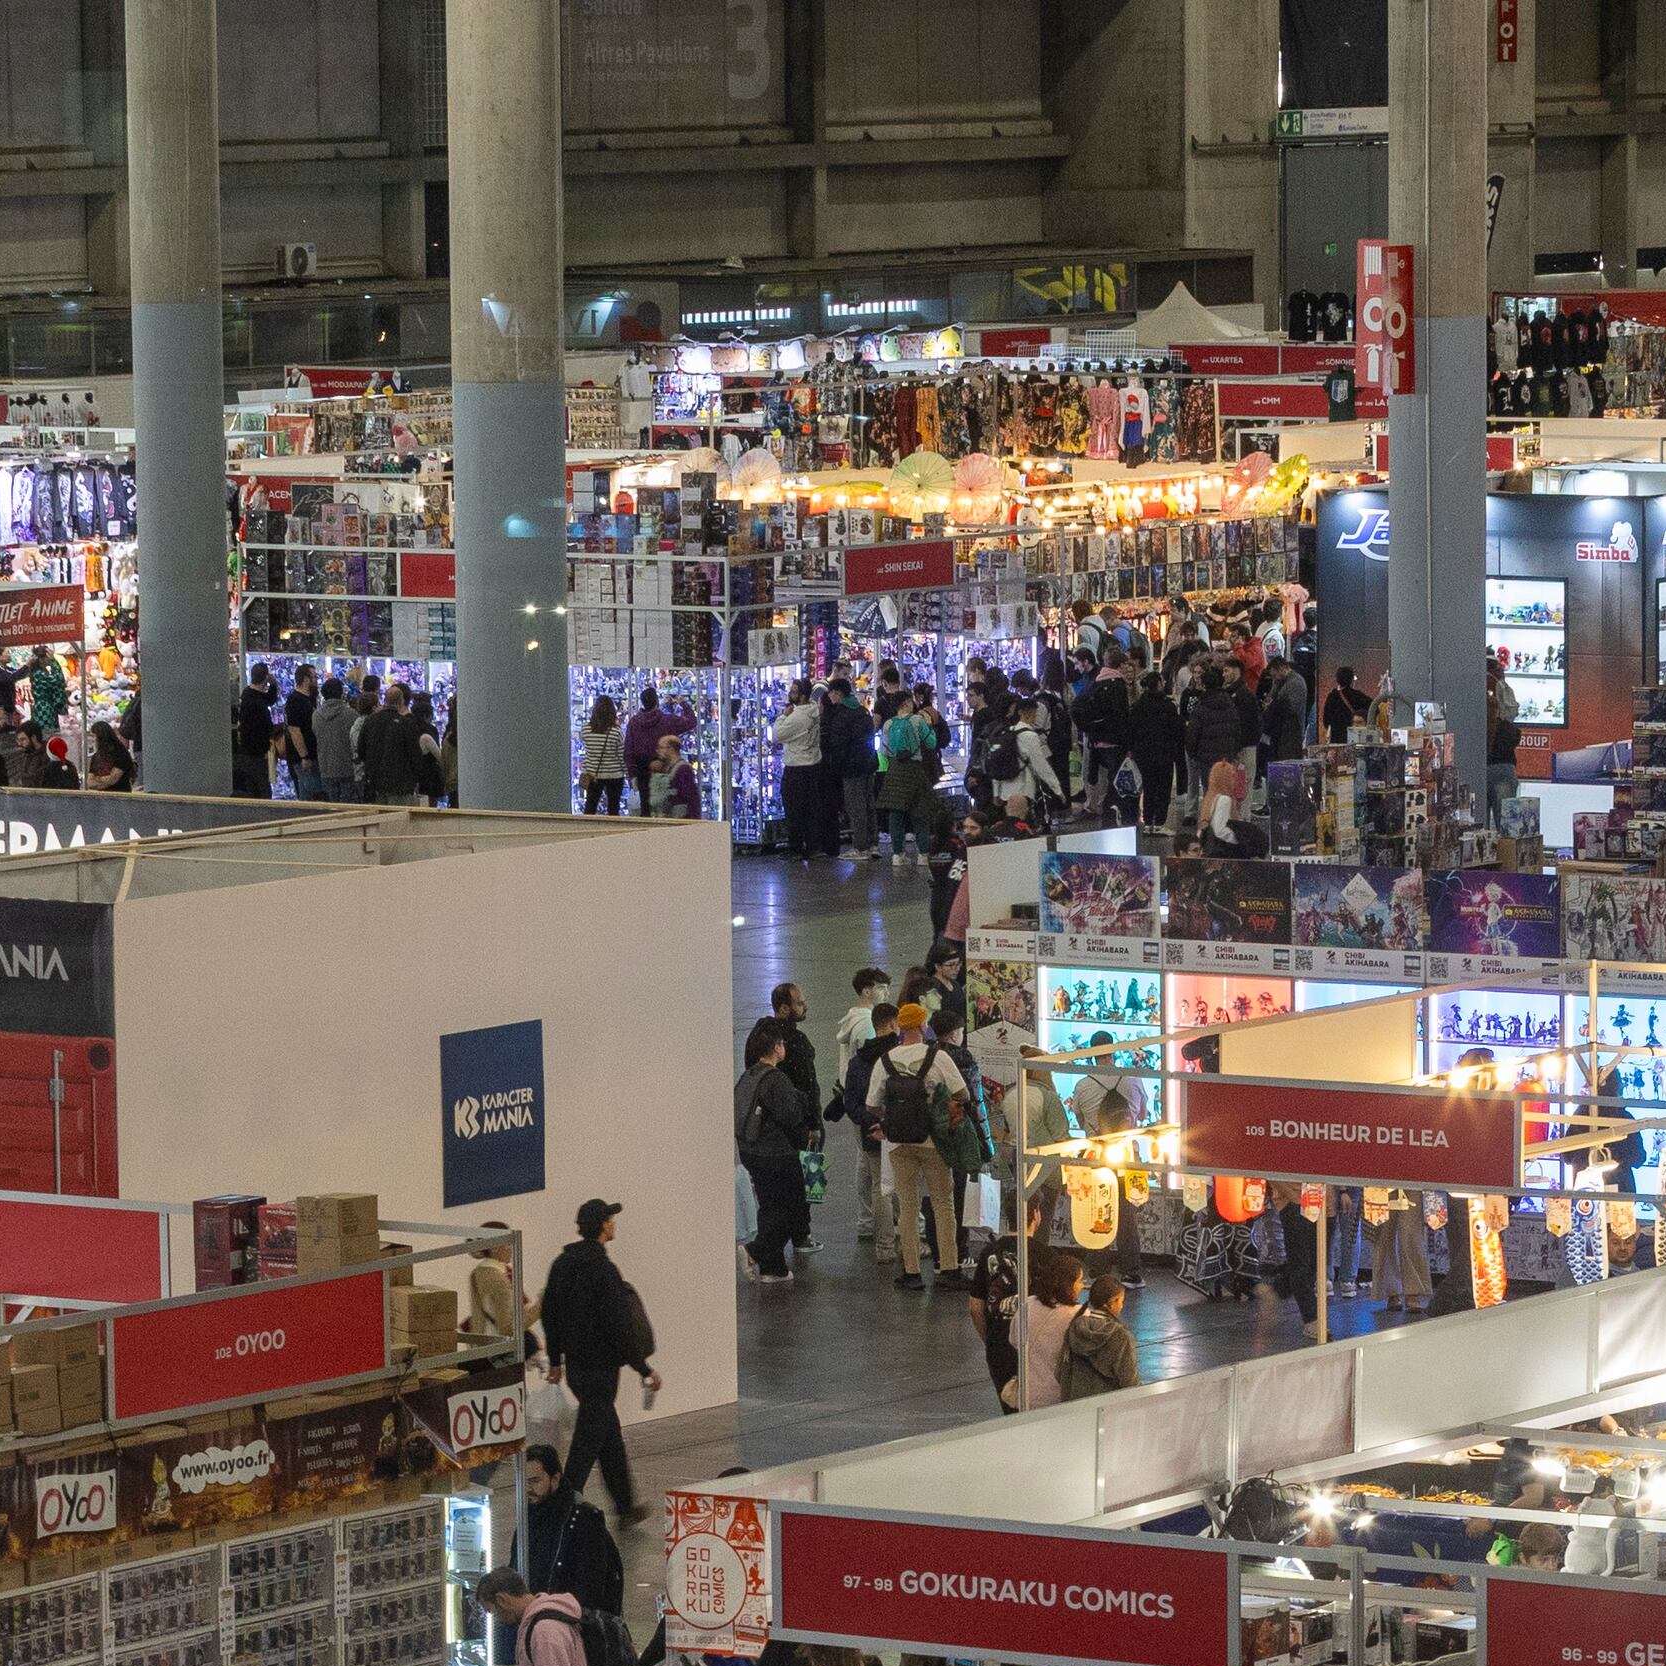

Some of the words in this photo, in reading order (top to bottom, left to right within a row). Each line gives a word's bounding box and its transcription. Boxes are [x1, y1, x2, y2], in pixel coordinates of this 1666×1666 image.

[727, 0, 771, 98] 3
[1209, 356, 1244, 365] UXARTEA
[1577, 544, 1631, 561] Simba
[885, 563, 902, 573] SHIN
[903, 560, 924, 572] SEKAI
[30, 598, 75, 617] ANIME
[1086, 938, 1106, 946] CHIBI
[1086, 945, 1130, 954] AKIHABARA
[1215, 945, 1235, 953] CHIBI
[1215, 953, 1260, 962] AKIHABARA
[1344, 952, 1365, 960] CHIBI
[1344, 959, 1390, 968] AKIHABARA
[1481, 959, 1502, 967] CHIBI
[1618, 972, 1664, 981] AKIHABARA
[482, 1087, 533, 1110] KARACTER
[483, 1105, 534, 1135] MANIA
[1245, 1125, 1265, 1136] 109
[1270, 1120, 1371, 1143] BONHEUR
[1376, 1127, 1404, 1145] DE
[1409, 1129, 1450, 1148] LEA
[215, 1347, 232, 1360] 102
[236, 1328, 285, 1357] OYOO
[180, 1448, 271, 1480] www.oyoo.fr
[685, 1546, 711, 1562] GO
[685, 1564, 711, 1579] KU
[685, 1582, 711, 1596] RA
[713, 1566, 726, 1615] COMICS
[843, 1573, 861, 1589] 97
[874, 1576, 893, 1591] 98
[900, 1569, 1058, 1608] GOKURAKU
[1064, 1585, 1175, 1619] COMICS
[685, 1598, 711, 1613] KU
[1561, 1647, 1582, 1662] 96
[1597, 1649, 1617, 1665] 99
